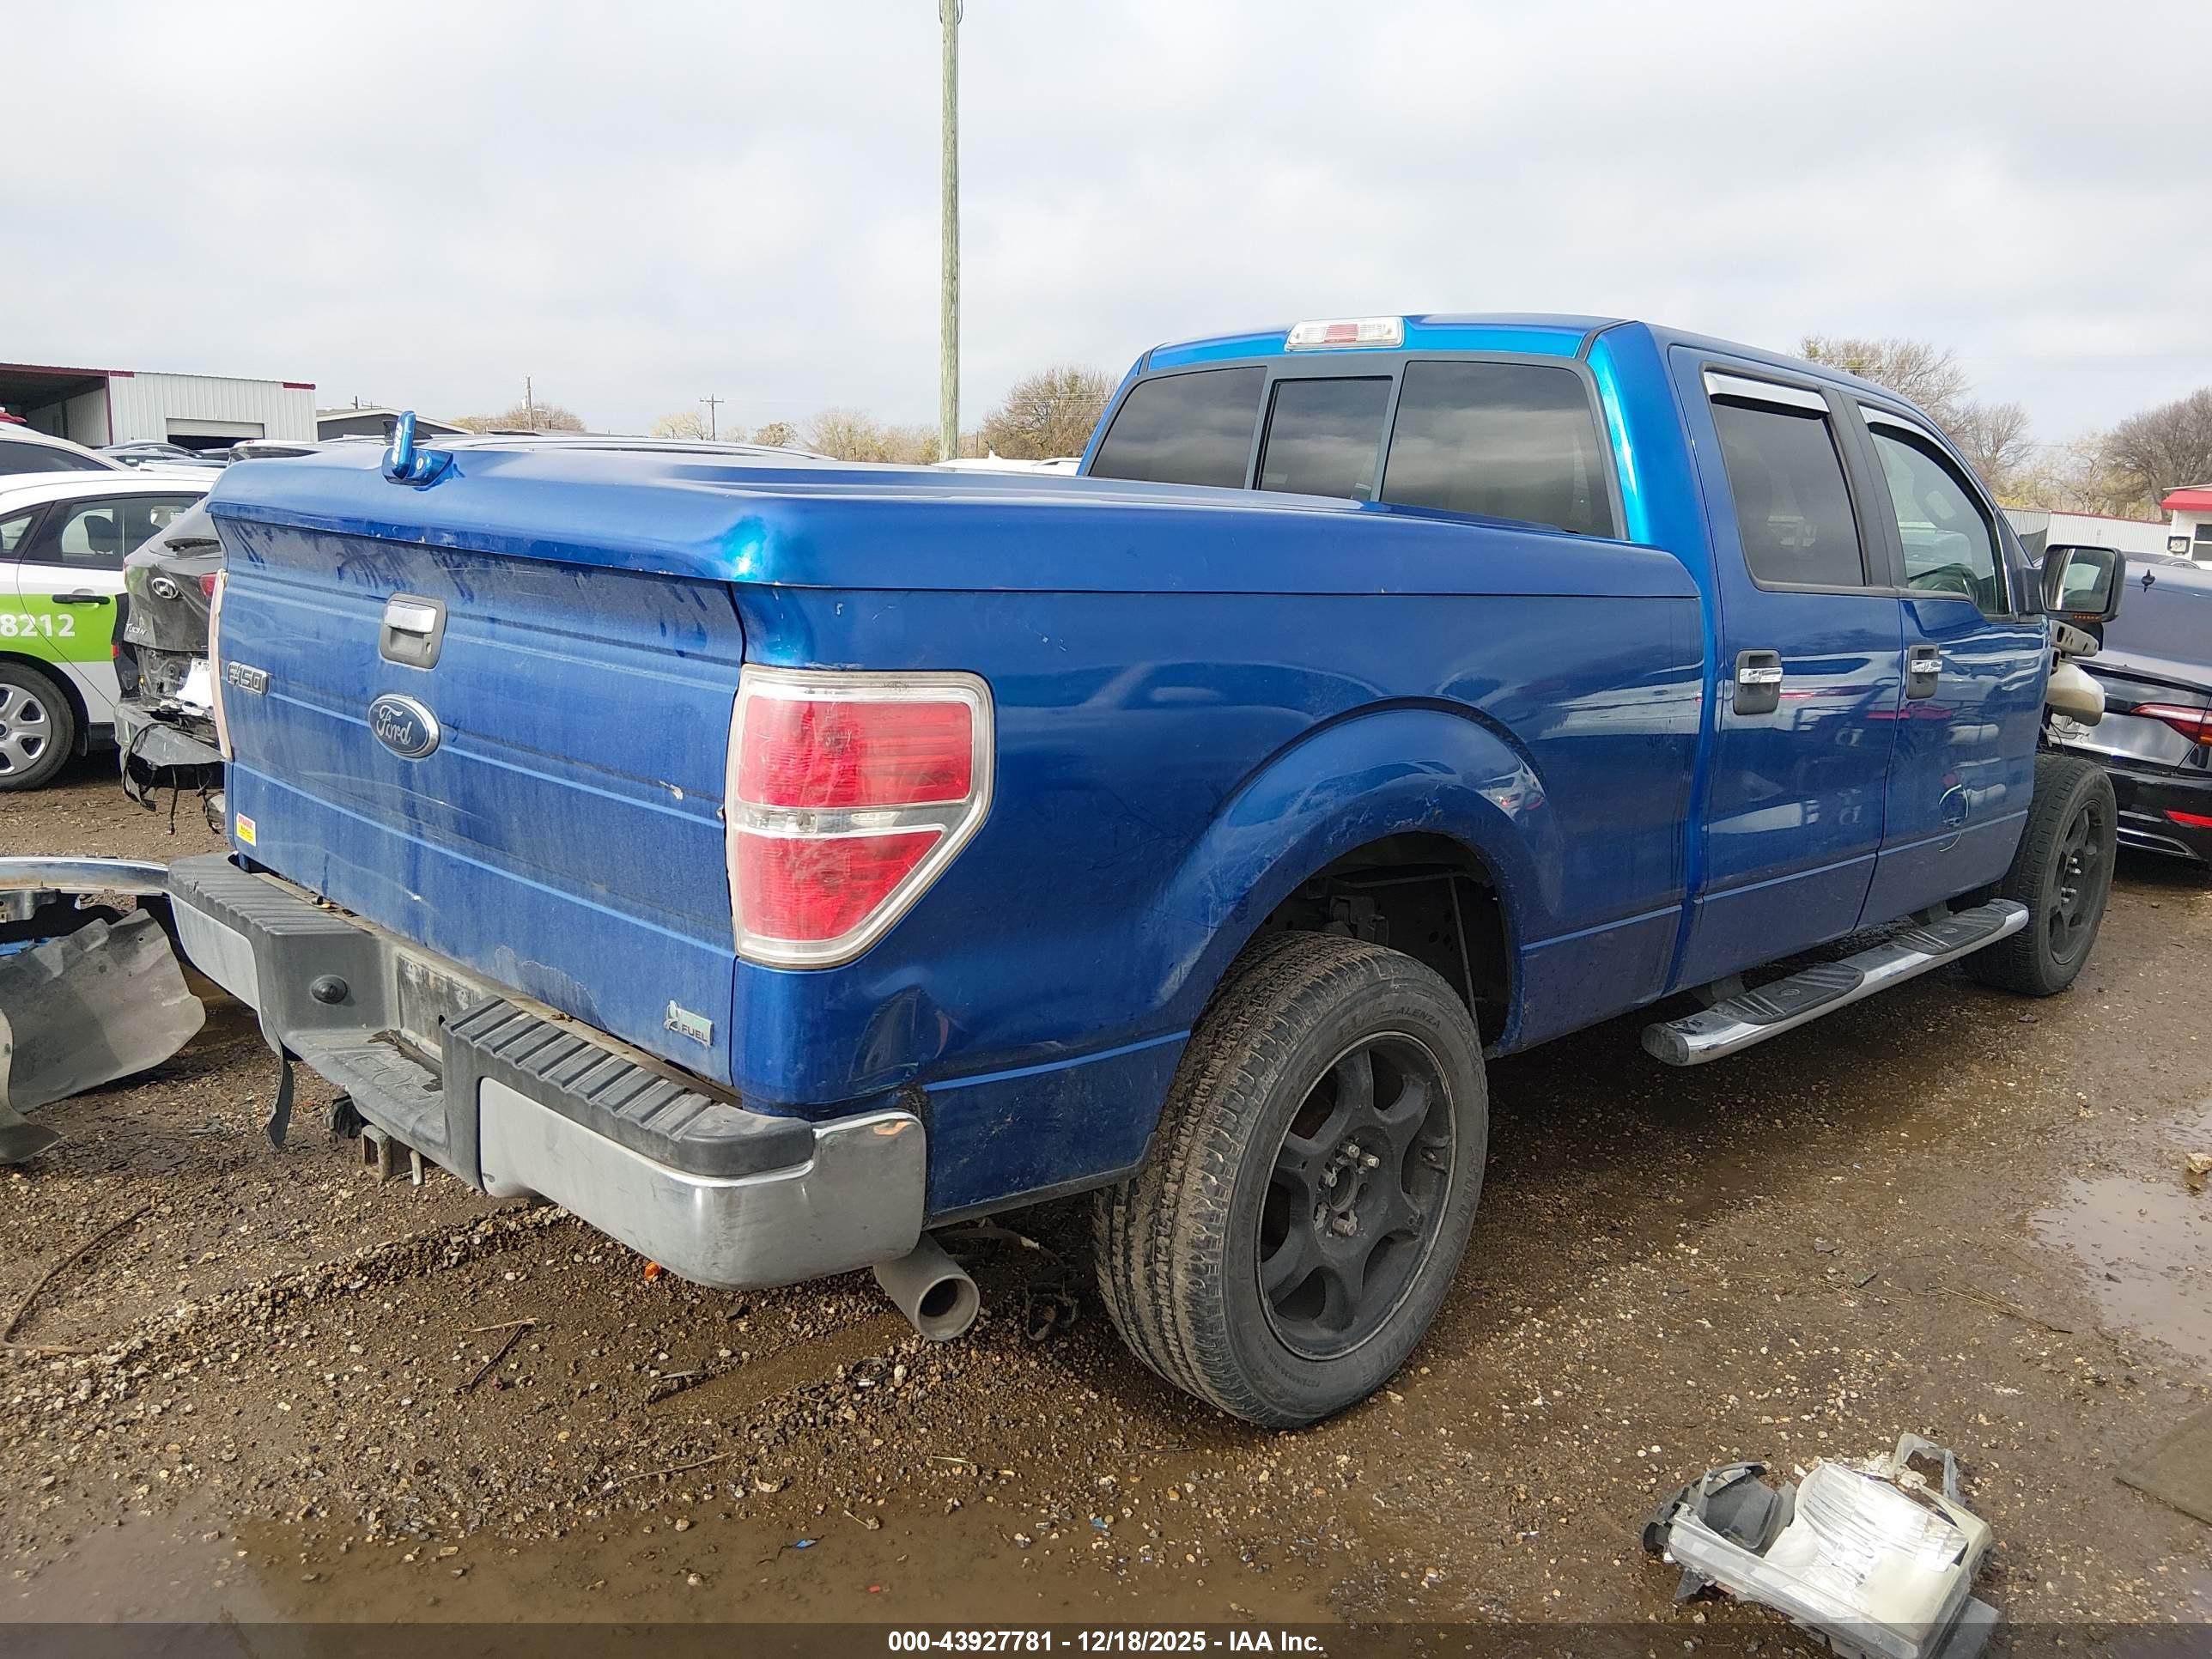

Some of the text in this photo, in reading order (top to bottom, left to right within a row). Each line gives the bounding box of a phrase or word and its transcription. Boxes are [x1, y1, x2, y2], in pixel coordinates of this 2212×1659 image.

[0, 613, 76, 637] 8212
[376, 705, 412, 745] Ford
[1395, 1006, 1441, 1029] ALENZA
[681, 1023, 708, 1042] FUEL
